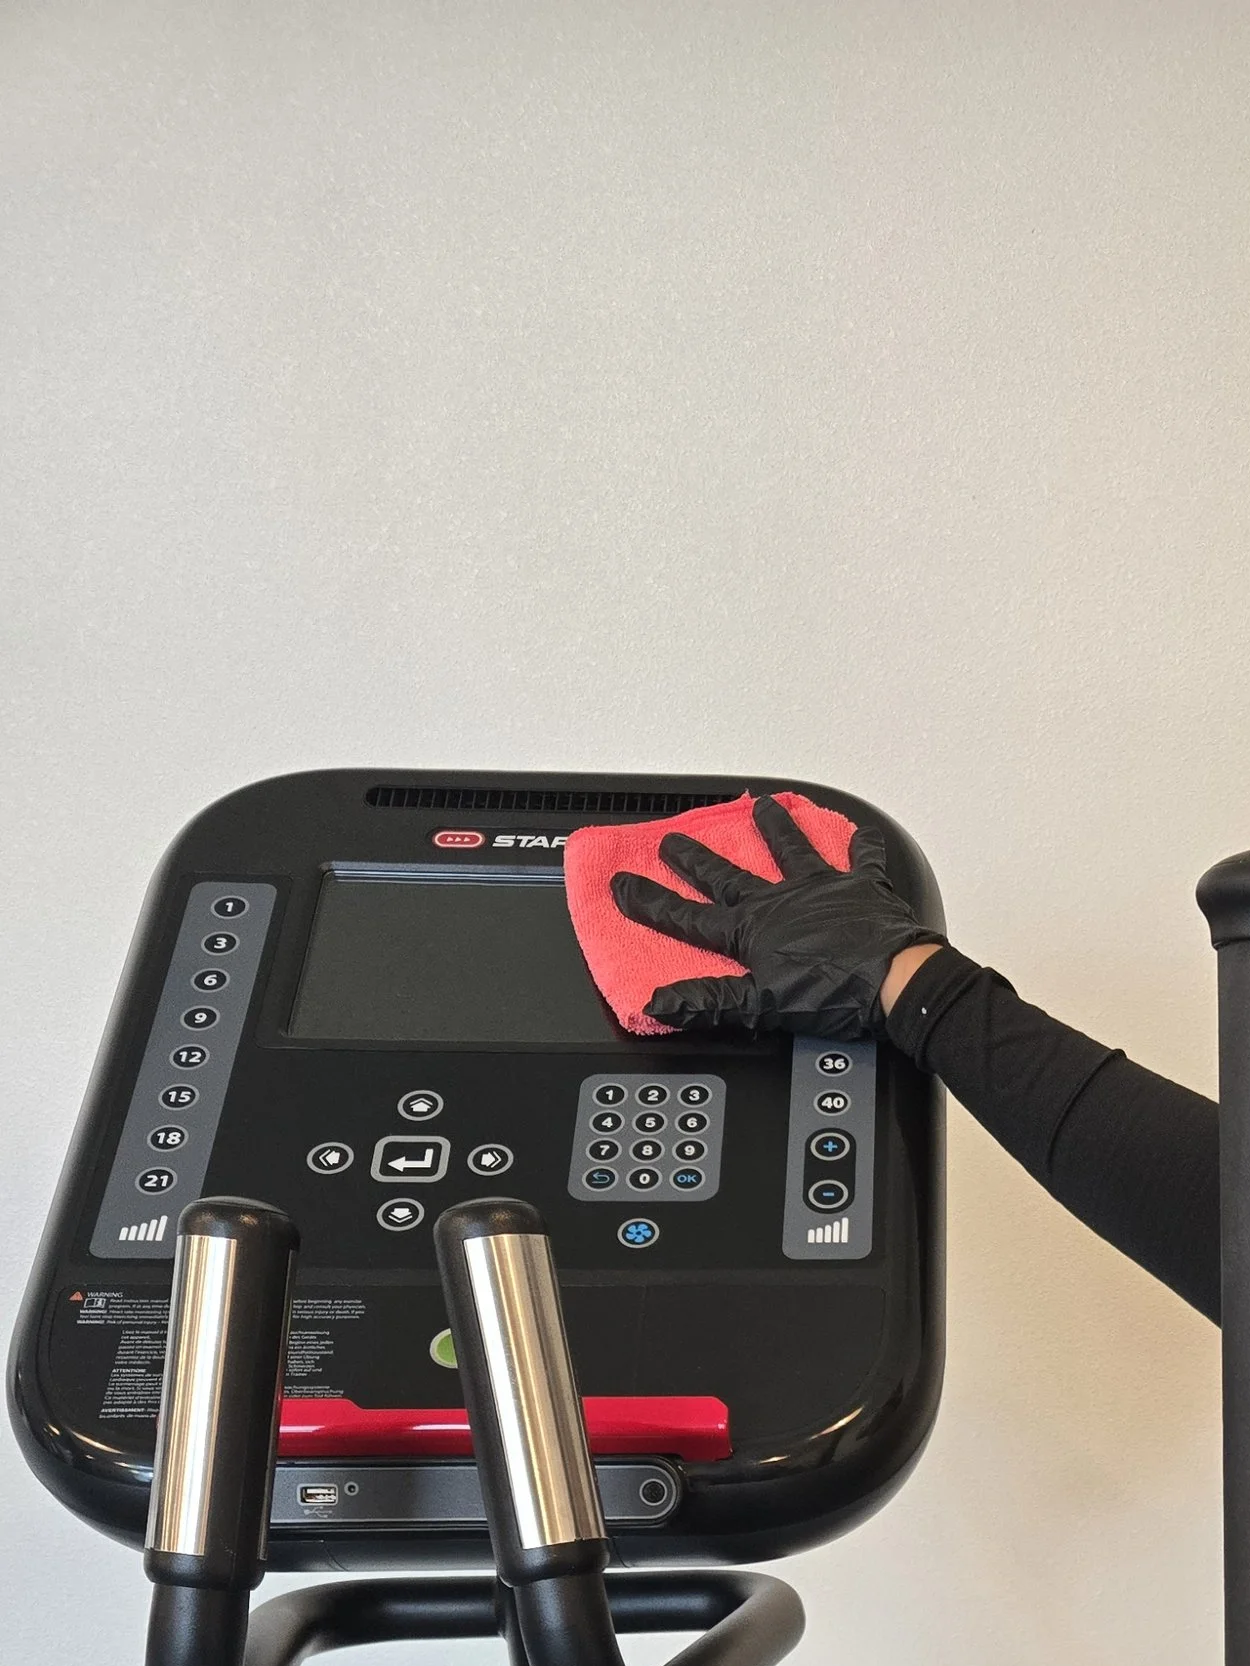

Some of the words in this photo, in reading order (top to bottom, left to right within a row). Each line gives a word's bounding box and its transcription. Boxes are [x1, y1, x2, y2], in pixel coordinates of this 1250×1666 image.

[213, 937, 227, 949] 3
[203, 974, 218, 986] 6
[194, 1012, 208, 1024] 9
[179, 1051, 202, 1063] 12
[823, 1058, 846, 1070] 36
[168, 1090, 192, 1103] 15
[605, 1089, 614, 1101] 1
[647, 1089, 659, 1101] 2
[688, 1089, 700, 1101] 3
[821, 1096, 845, 1109] 40
[601, 1116, 613, 1128] 4
[645, 1117, 656, 1128] 5
[686, 1117, 698, 1128] 6
[157, 1131, 182, 1145] 18
[599, 1144, 610, 1156] 7
[641, 1144, 653, 1156] 8
[684, 1144, 696, 1156] 9
[144, 1174, 169, 1187] 21
[639, 1173, 651, 1185] 0
[677, 1174, 697, 1183] OK
